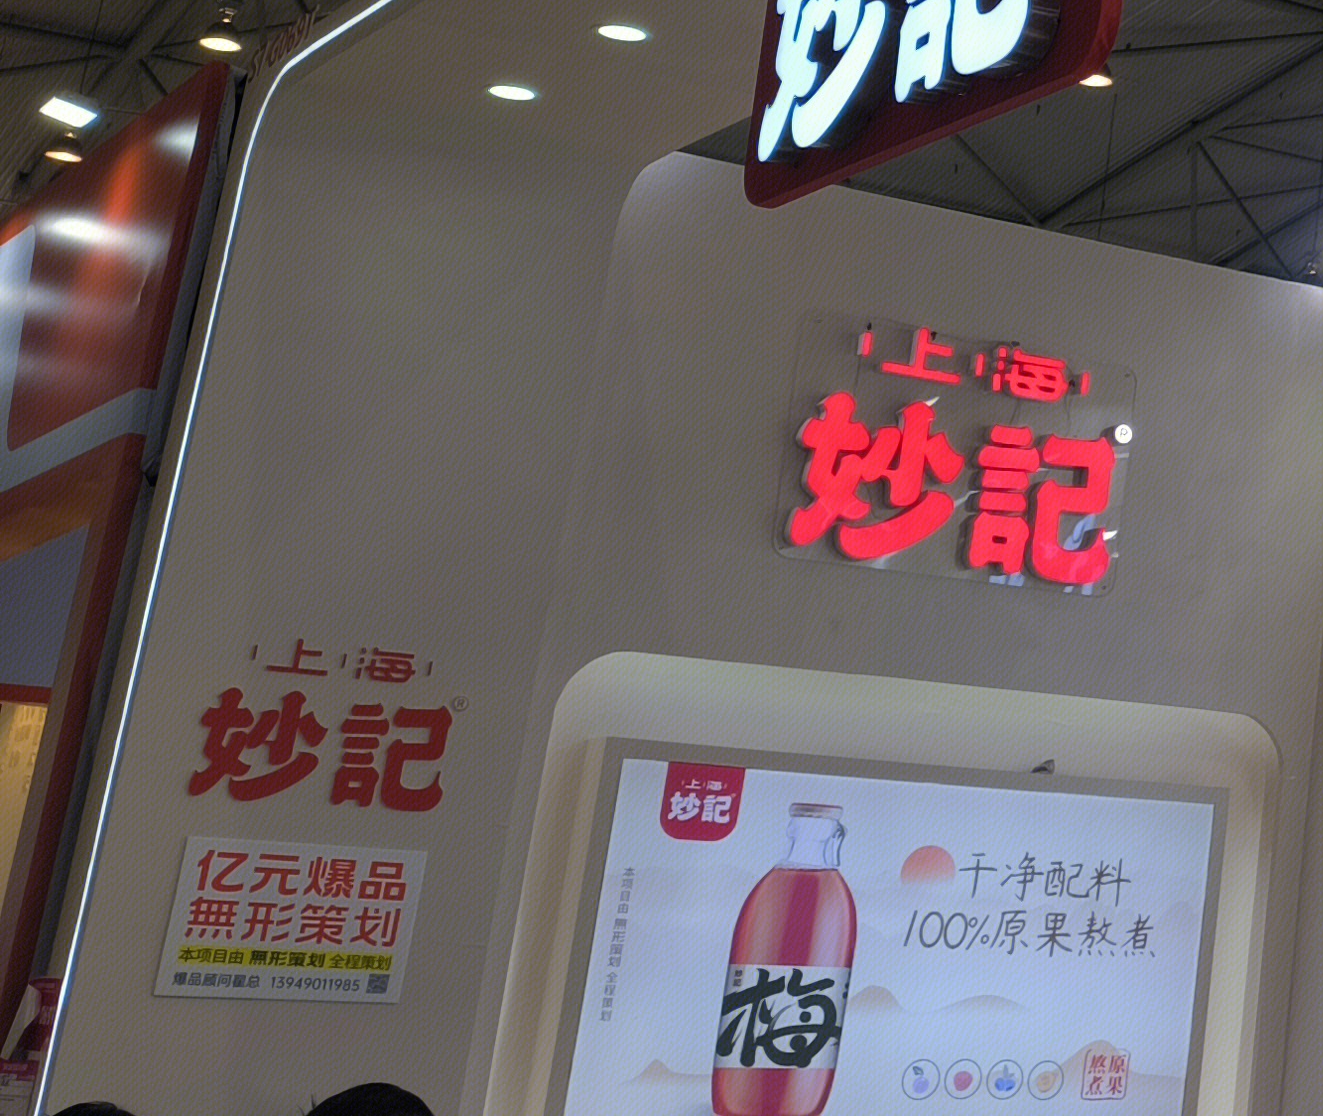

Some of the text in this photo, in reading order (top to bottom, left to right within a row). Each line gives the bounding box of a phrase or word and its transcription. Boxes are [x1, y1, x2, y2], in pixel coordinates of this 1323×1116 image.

[880, 327, 1069, 403] 上海
[789, 391, 1116, 586] 妙記
[266, 638, 417, 684] 上海
[188, 687, 453, 812] 妙記
[667, 791, 733, 824] 妙記
[197, 849, 408, 902] 亿元爆品
[959, 852, 1131, 907] 干净配料
[184, 896, 402, 948] 無形策划
[903, 910, 1156, 958] 100%原果熬煮
[178, 947, 244, 965] 本项目由
[270, 976, 361, 992] 13949011985
